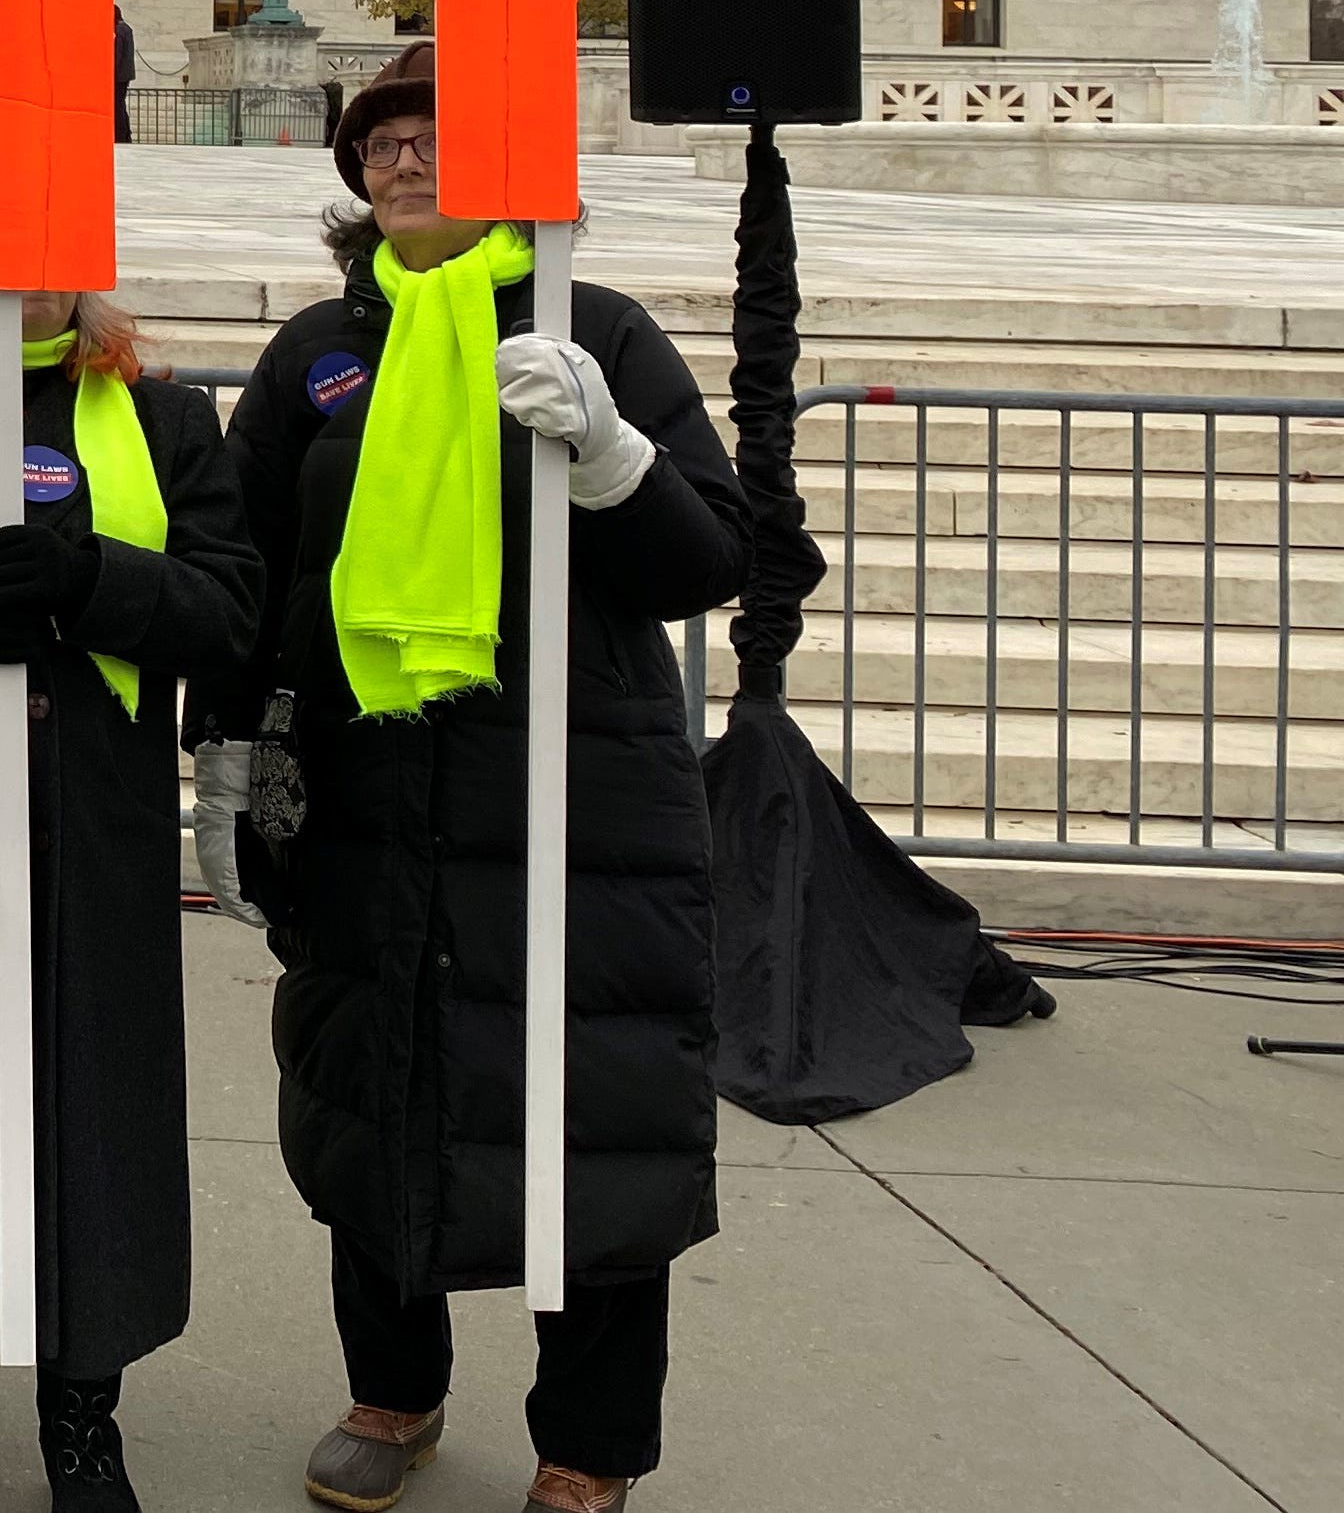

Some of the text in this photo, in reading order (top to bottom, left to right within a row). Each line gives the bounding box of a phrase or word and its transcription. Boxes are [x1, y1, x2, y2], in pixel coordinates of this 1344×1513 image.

[23, 463, 69, 473] UN LAWS
[23, 473, 69, 482] AVE LIVES
